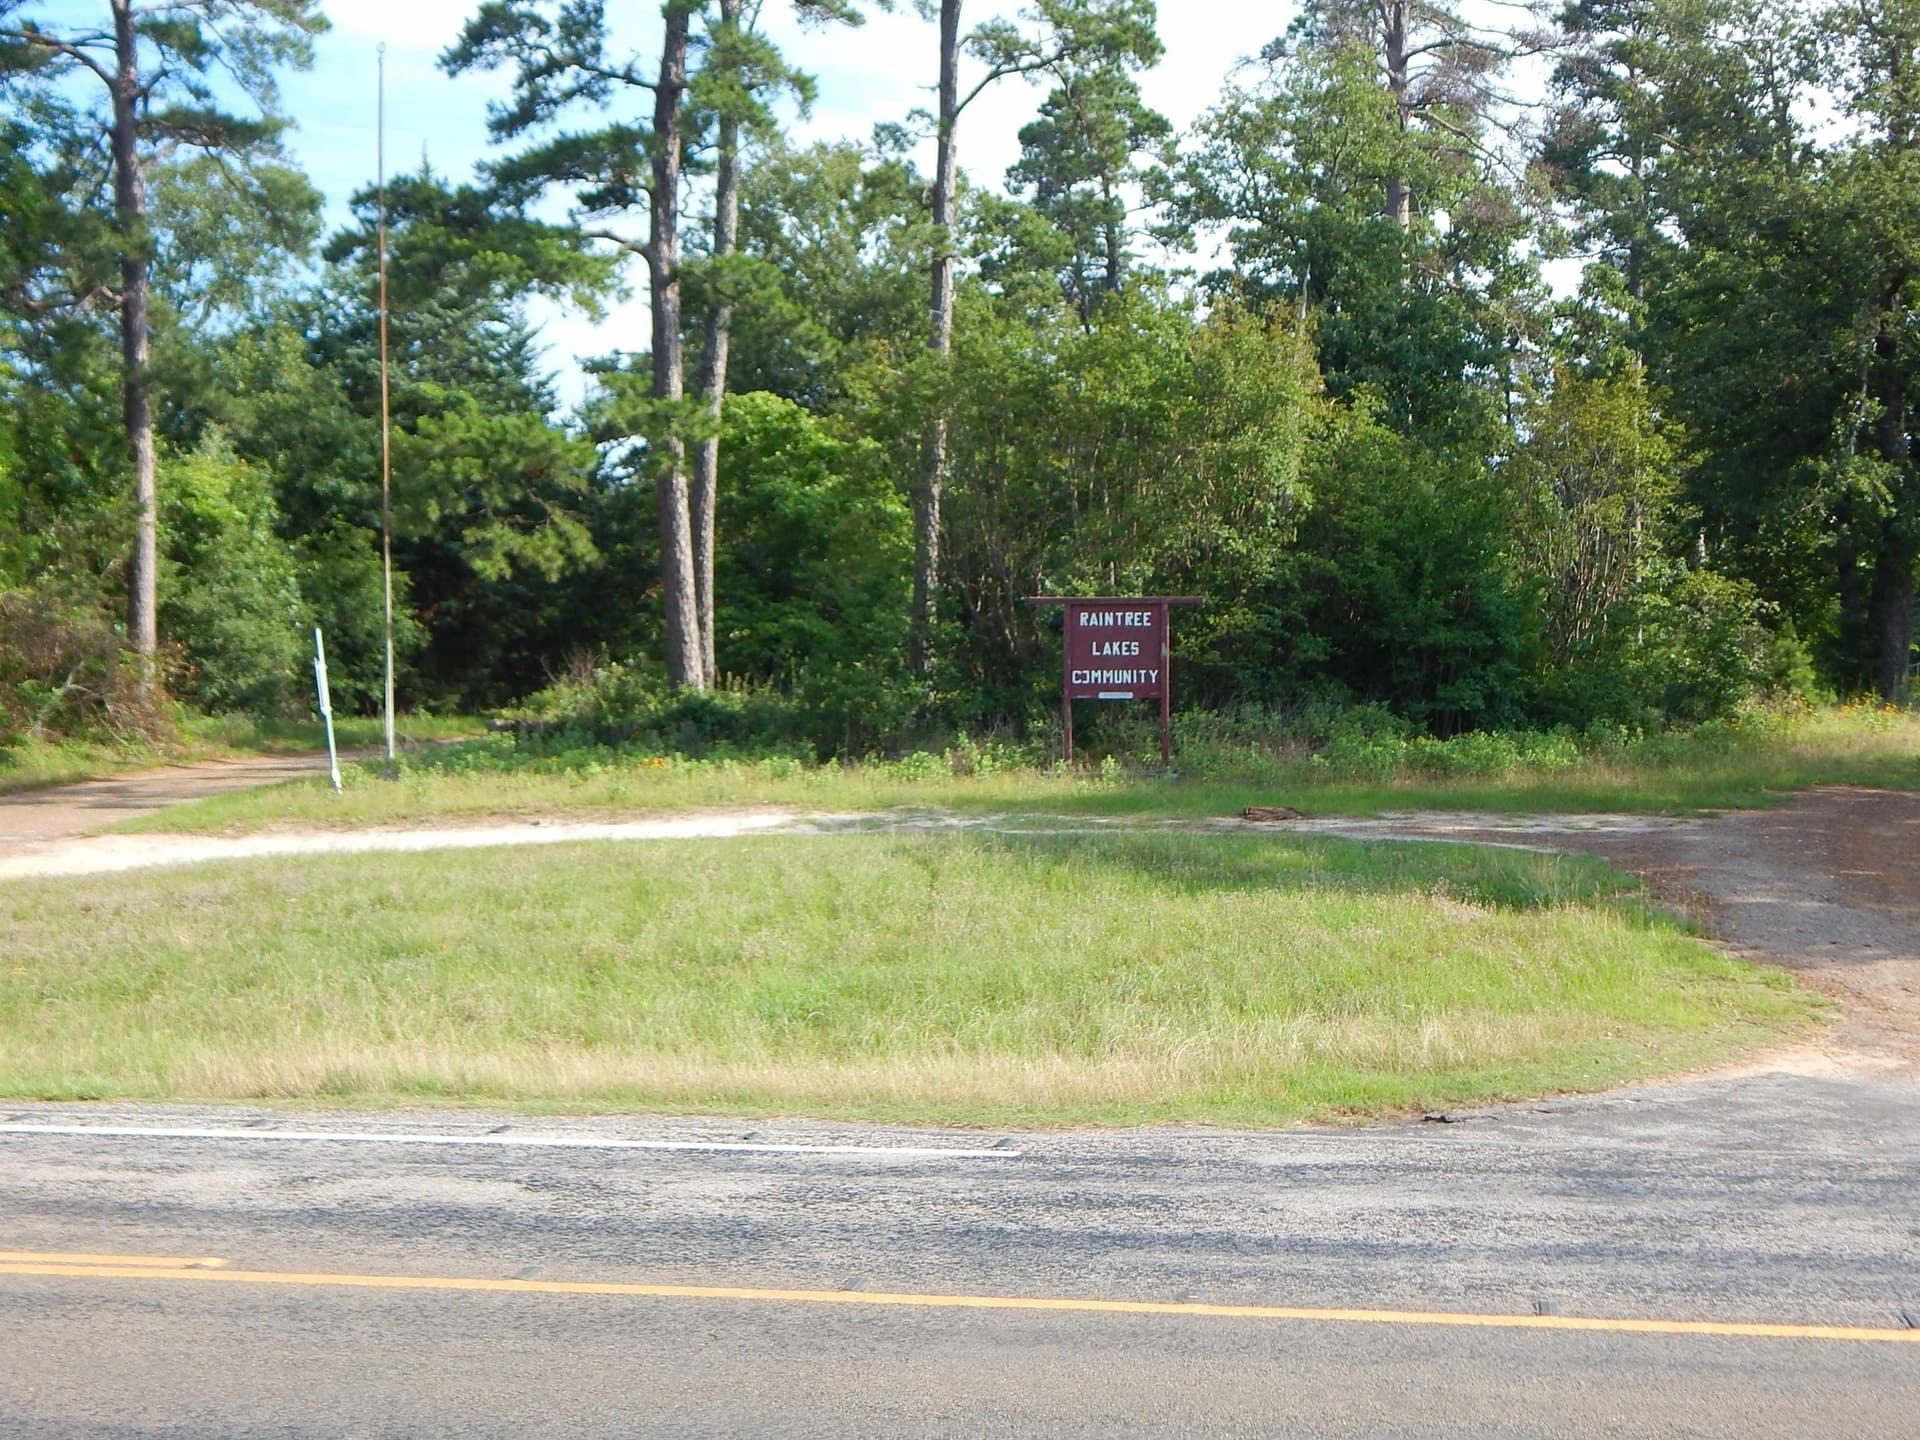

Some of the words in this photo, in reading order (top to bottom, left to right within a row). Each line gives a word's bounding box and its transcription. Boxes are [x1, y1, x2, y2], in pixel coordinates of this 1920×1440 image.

[1080, 612, 1151, 626] RAINTREE
[1092, 641, 1139, 655] LAKES
[1072, 670, 1158, 684] COMMUNITY
